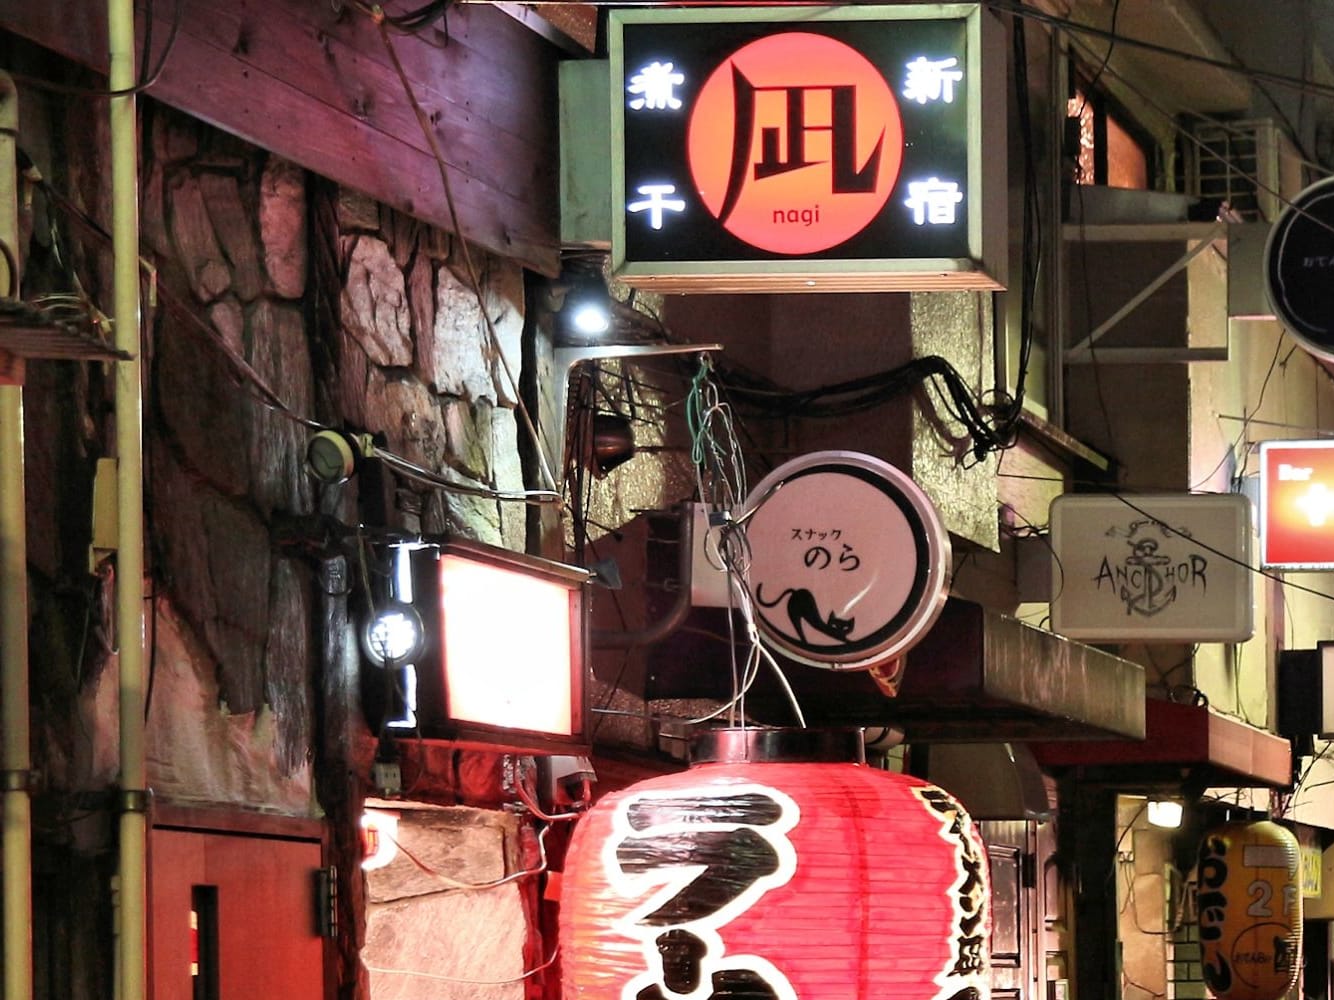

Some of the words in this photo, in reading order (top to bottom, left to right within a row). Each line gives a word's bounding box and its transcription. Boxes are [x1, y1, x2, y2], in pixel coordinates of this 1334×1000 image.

[628, 61, 686, 230] 煮干
[717, 60, 886, 226] 凪
[904, 56, 963, 225] 新宿
[772, 204, 820, 226] nagi
[791, 526, 842, 542] スナック
[804, 543, 861, 572] のら
